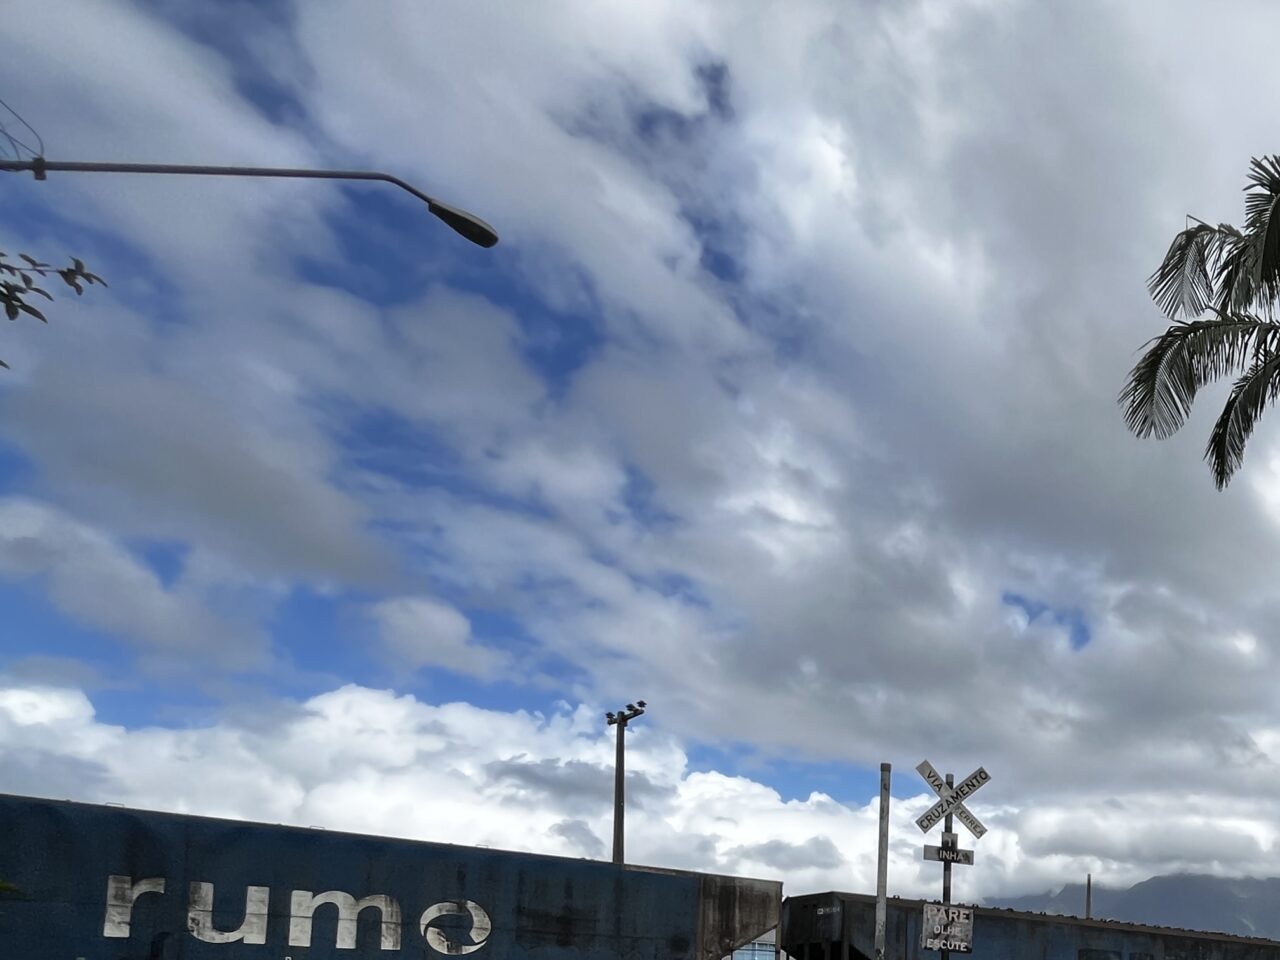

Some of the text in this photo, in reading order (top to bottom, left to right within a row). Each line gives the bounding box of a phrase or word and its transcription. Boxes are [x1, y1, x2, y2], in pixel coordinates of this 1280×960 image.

[927, 771, 943, 792] VIA
[920, 770, 988, 829] CRUZAMENTO
[103, 874, 492, 956] rumo
[927, 906, 970, 923] PARE
[933, 925, 962, 936] OLHE
[926, 938, 968, 951] ESCUTE
